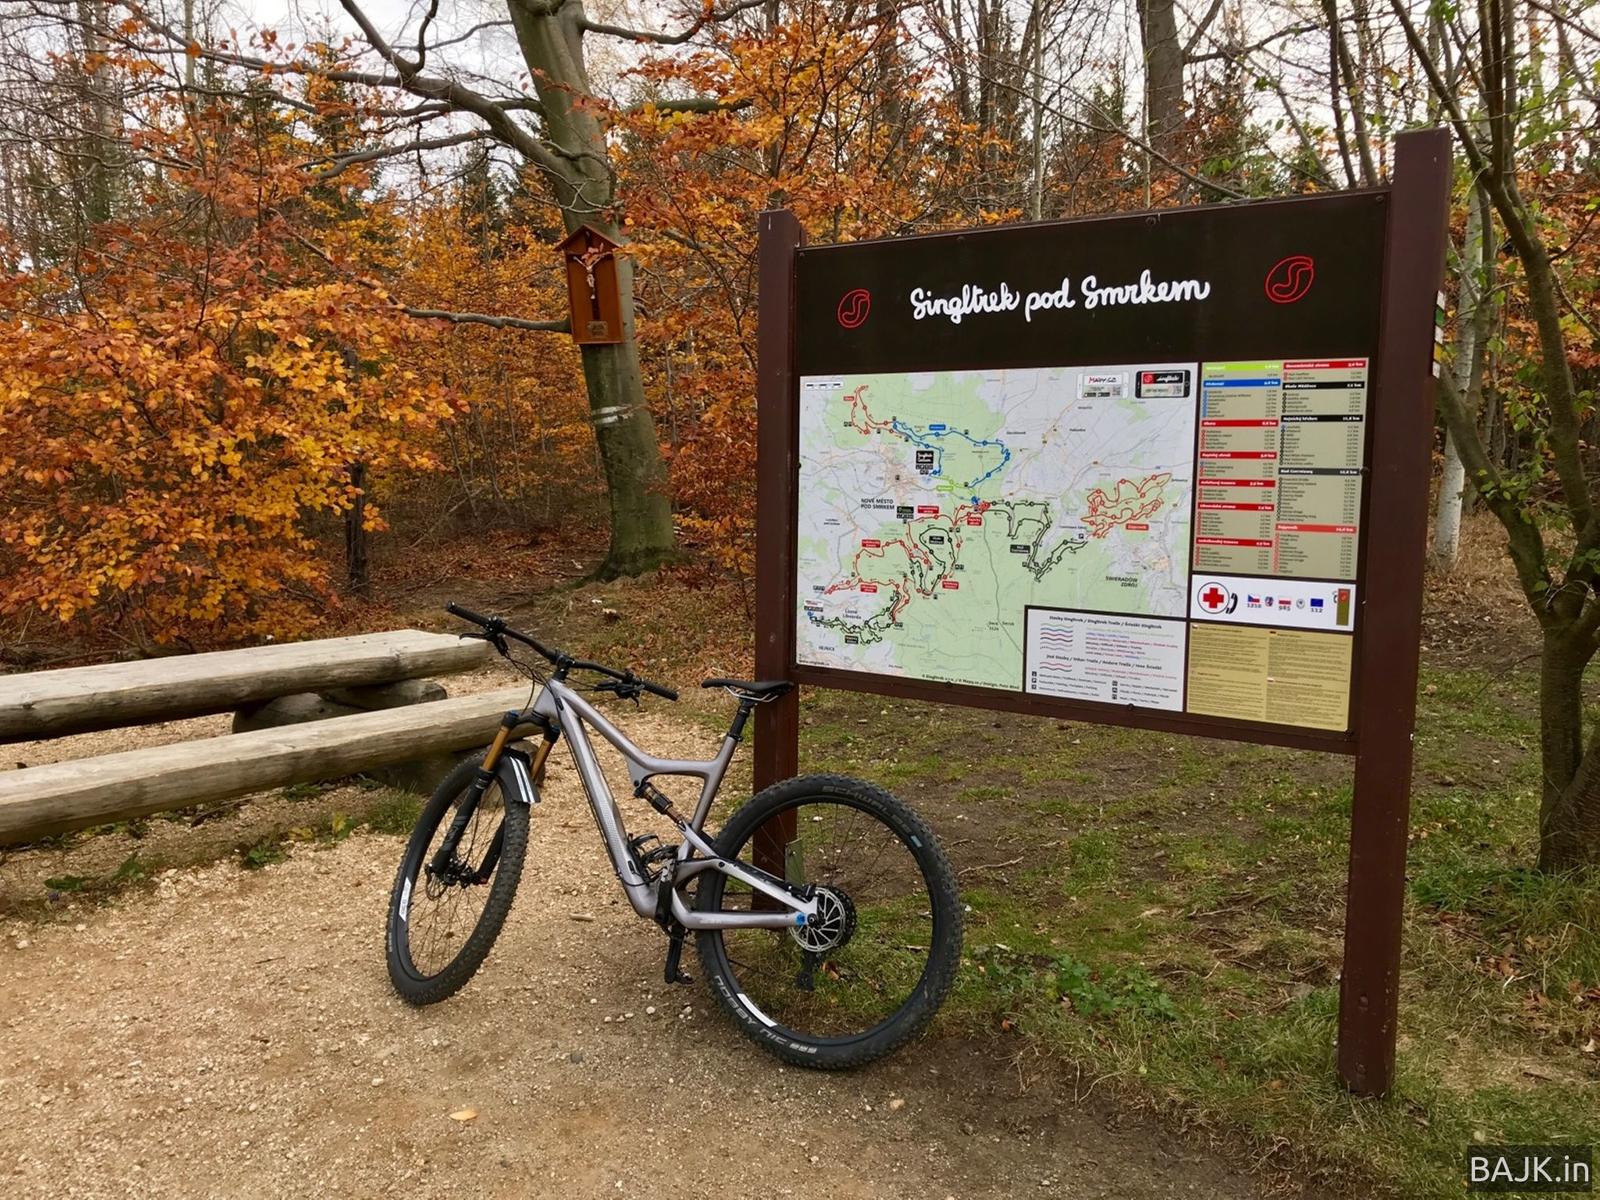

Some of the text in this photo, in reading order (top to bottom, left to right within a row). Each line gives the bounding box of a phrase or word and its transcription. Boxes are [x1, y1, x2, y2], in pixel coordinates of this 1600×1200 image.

[910, 269, 1210, 324] Singltrek pod Smrkem
